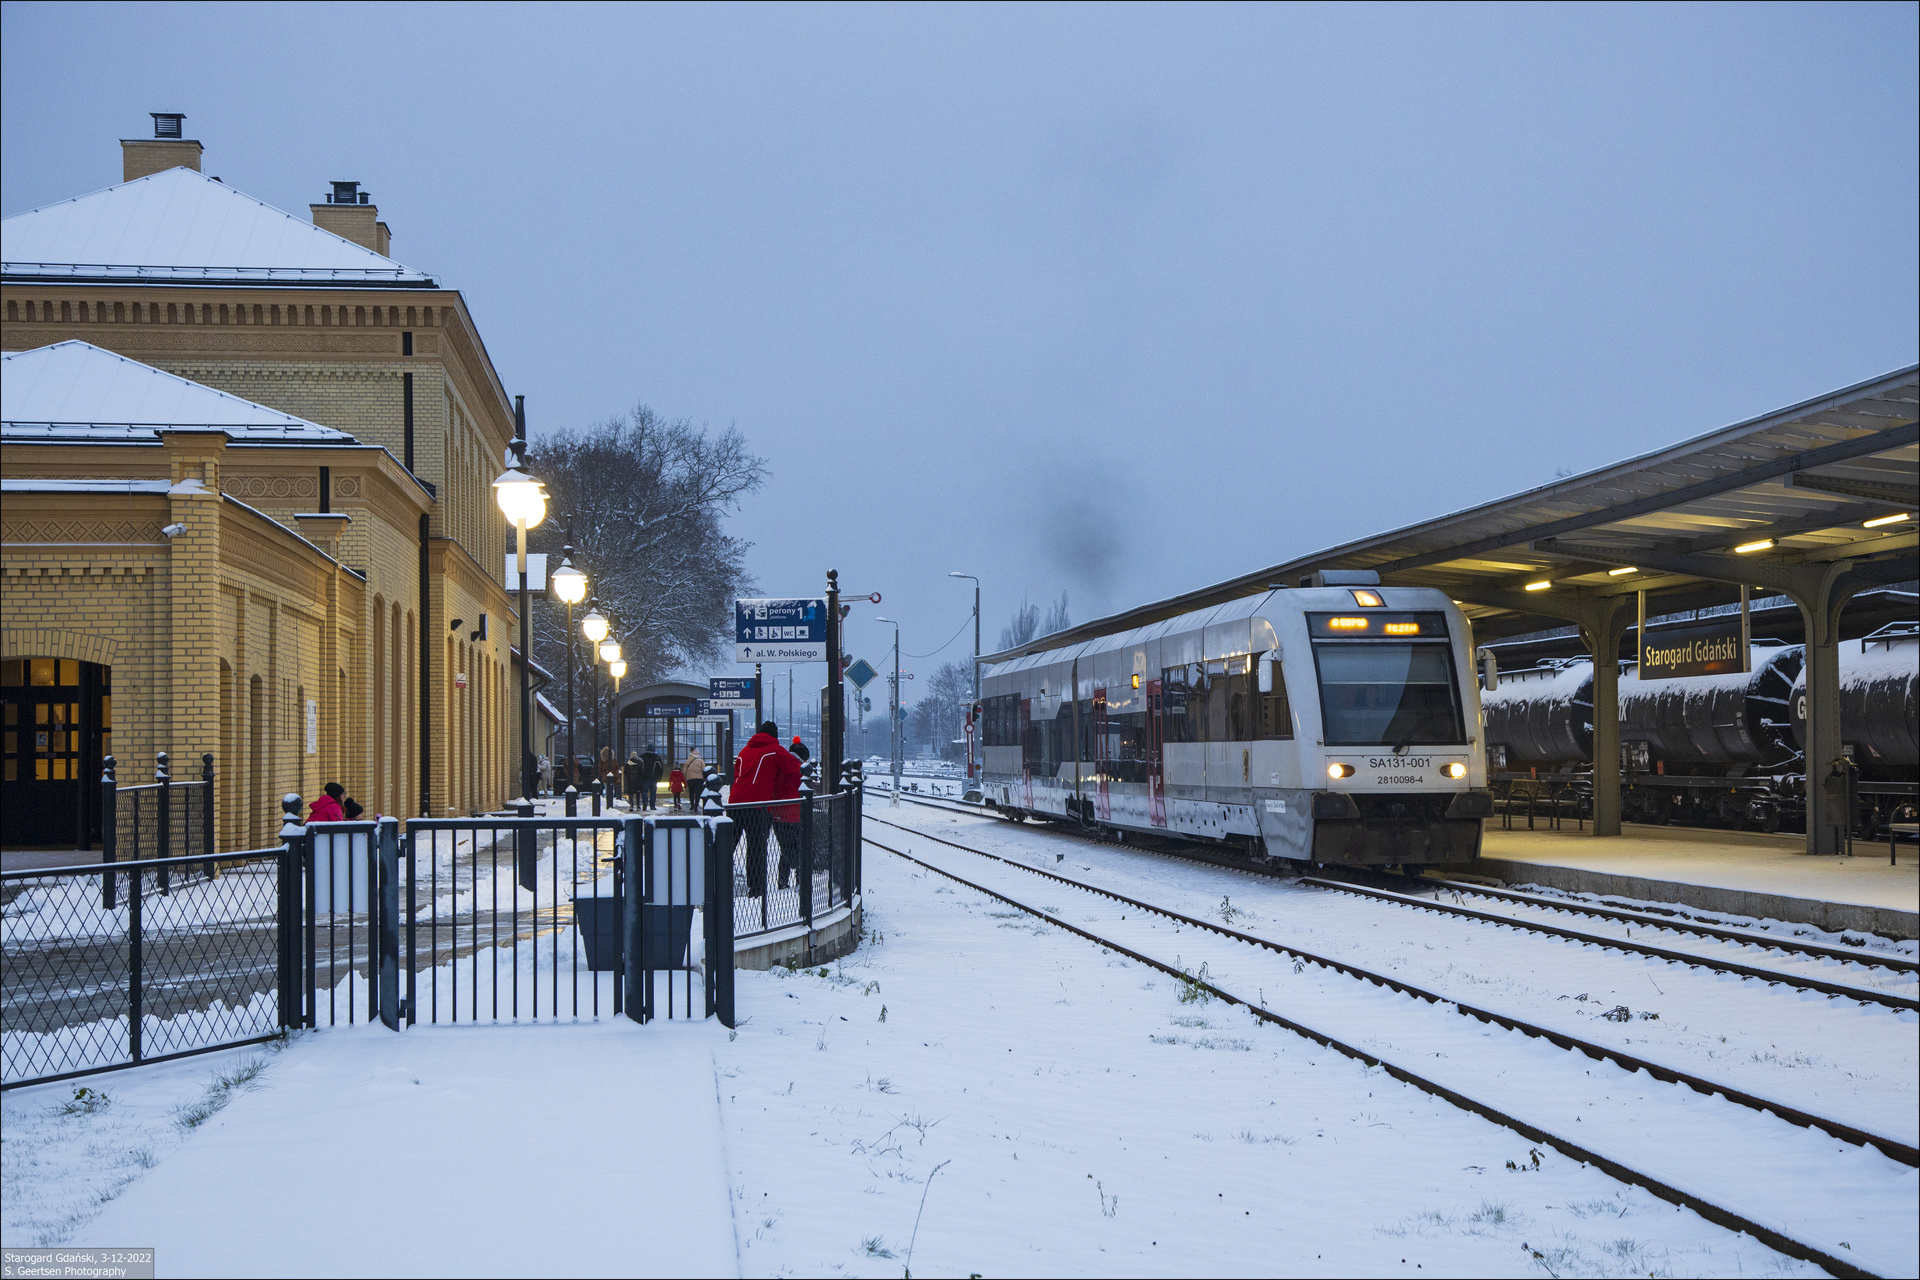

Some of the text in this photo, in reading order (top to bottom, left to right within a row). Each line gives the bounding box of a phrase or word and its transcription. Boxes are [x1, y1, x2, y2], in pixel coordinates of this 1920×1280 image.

[769, 607, 796, 615] perony
[756, 649, 818, 659] al. W. Polskiego
[1645, 637, 1737, 670] Starogard Gdański
[1369, 758, 1431, 768] SA131-001
[1377, 776, 1424, 785] 2810098-4
